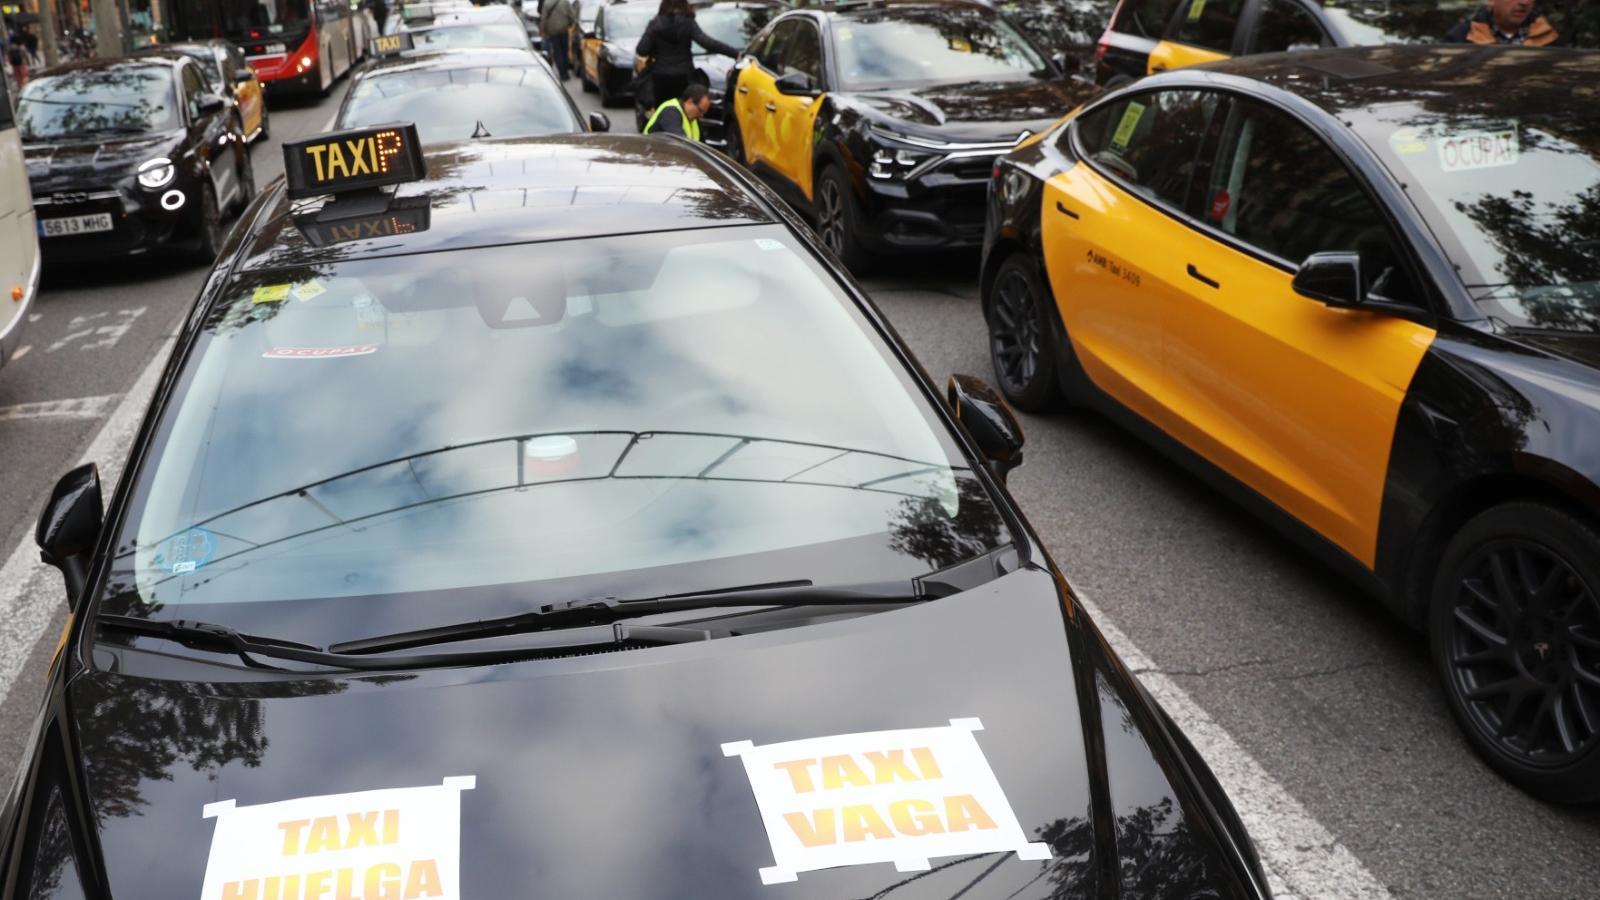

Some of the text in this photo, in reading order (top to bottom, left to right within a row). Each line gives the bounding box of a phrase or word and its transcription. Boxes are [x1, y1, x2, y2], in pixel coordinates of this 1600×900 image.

[375, 34, 400, 53] TAXI
[1443, 132, 1513, 166] OCUPAT
[45, 215, 109, 234] 5613 MHG
[274, 344, 373, 356] OCUPAT
[773, 746, 944, 794] TAXI
[277, 809, 400, 857] TAXI
[782, 794, 999, 848] VAGA
